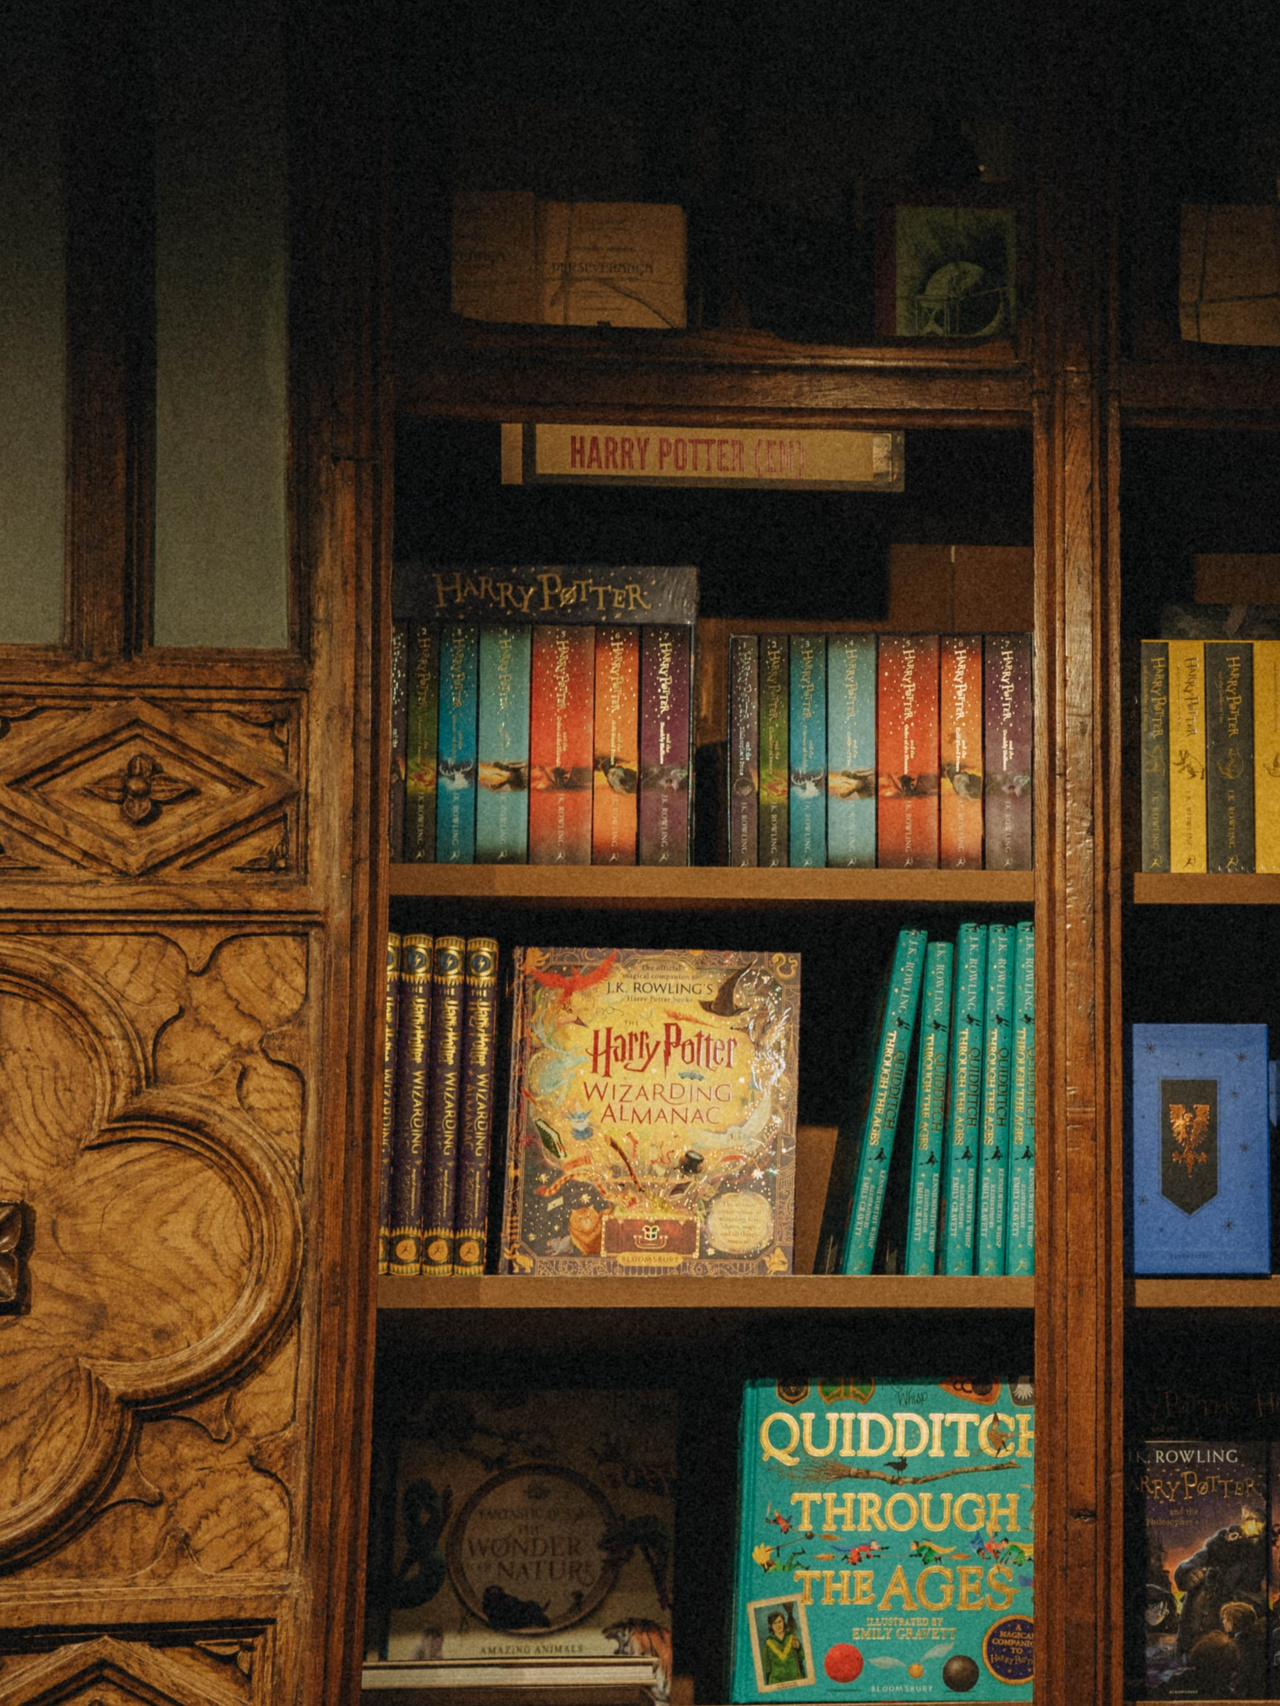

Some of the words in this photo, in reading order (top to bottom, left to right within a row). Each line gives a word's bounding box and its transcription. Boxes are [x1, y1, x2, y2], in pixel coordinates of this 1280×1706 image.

[571, 435, 650, 469] HARRY
[659, 438, 744, 472] POTTER
[754, 439, 805, 479] (EN)
[433, 572, 537, 613] HARRY
[536, 572, 651, 612] POTTER
[1225, 656, 1241, 695] HARRY
[1226, 695, 1242, 738] POTTER
[607, 982, 628, 995] J.K.
[633, 982, 713, 995] ROWLING'S
[898, 962, 915, 1014] ROWLING
[933, 964, 946, 1016] ROWLING
[967, 958, 979, 1011] ROWLING
[996, 958, 1008, 1011] ROWLING
[1024, 958, 1034, 1010] ROWLING
[585, 1027, 661, 1078] Harry
[663, 1023, 739, 1079] Potter
[878, 1030, 897, 1089] THROUGH
[922, 1034, 934, 1093] THROUGH
[957, 1028, 969, 1088] THROUGH
[985, 1028, 998, 1088] THROUGH
[1015, 1028, 1027, 1087] THROUGH
[583, 1081, 733, 1105] WIZARDING
[875, 1091, 888, 1114] THE
[883, 1050, 907, 1130] QUIDDITCH
[921, 1095, 932, 1118] THE
[932, 1052, 946, 1133] QUIDDITCH
[956, 1090, 967, 1113] THE
[966, 1047, 981, 1127] QUIDDITCH
[985, 1090, 996, 1113] THE
[996, 1047, 1010, 1127] QUIDDITCH
[1014, 1090, 1025, 1113] THE
[410, 1070, 425, 1154] WIZARDING
[442, 1072, 457, 1156] WIZARDING
[474, 1073, 488, 1157] WIZARDING
[601, 1103, 721, 1125] ALMANAC
[869, 1115, 884, 1146] AGES
[954, 1115, 966, 1145] AGES
[983, 1115, 995, 1145] AGES
[1013, 1114, 1024, 1145] AGES
[918, 1120, 931, 1151] AGES
[621, 1255, 679, 1264] BLOOMSBURY
[1155, 1449, 1239, 1463] ROWLING
[1181, 1470, 1263, 1500] POTTER
[790, 1492, 1021, 1532] THROUGH
[793, 1569, 876, 1606] THE
[877, 1564, 1015, 1612] AGES
[851, 1627, 894, 1641] EMILY
[895, 1627, 958, 1641] GRAVETT
[866, 1617, 930, 1627] ILLUSTRATED
[931, 1617, 944, 1627] BY
[1015, 1623, 1022, 1631] A
[481, 1645, 531, 1656] AMAZING
[536, 1644, 584, 1655] ANIMALS
[1010, 1646, 1023, 1655] TO
[870, 1685, 933, 1693] BLOOMSBURY
